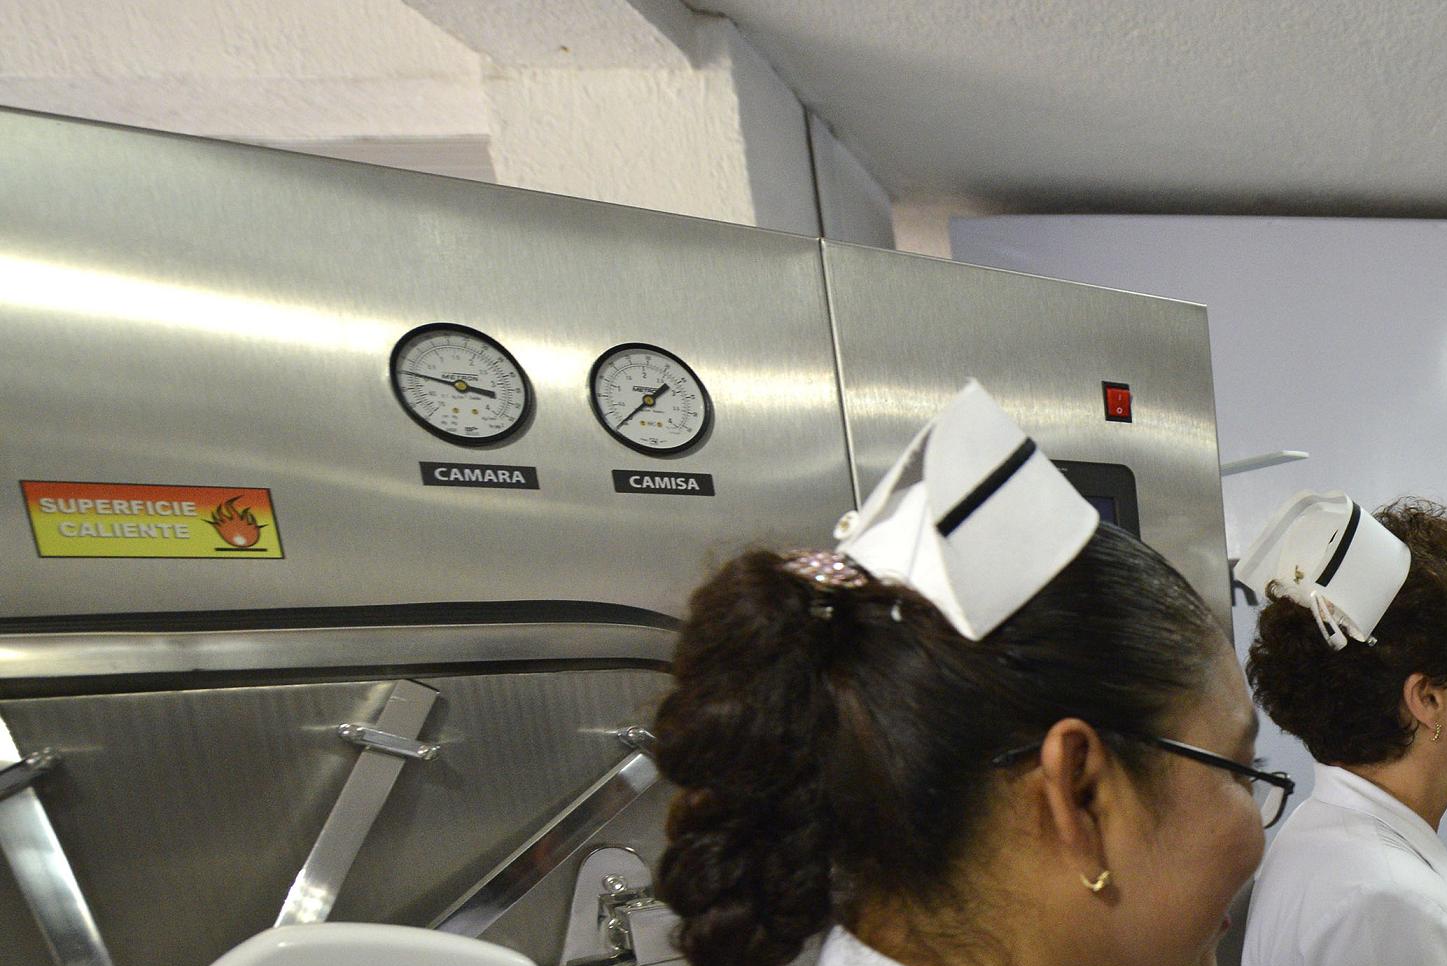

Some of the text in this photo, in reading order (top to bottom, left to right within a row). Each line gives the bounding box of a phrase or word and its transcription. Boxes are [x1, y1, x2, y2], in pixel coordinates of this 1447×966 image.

[434, 467, 526, 484] CAMARA
[629, 475, 700, 491] CAMISA
[39, 497, 198, 516] SUPERFICIE
[59, 521, 190, 539] CALIENTE
